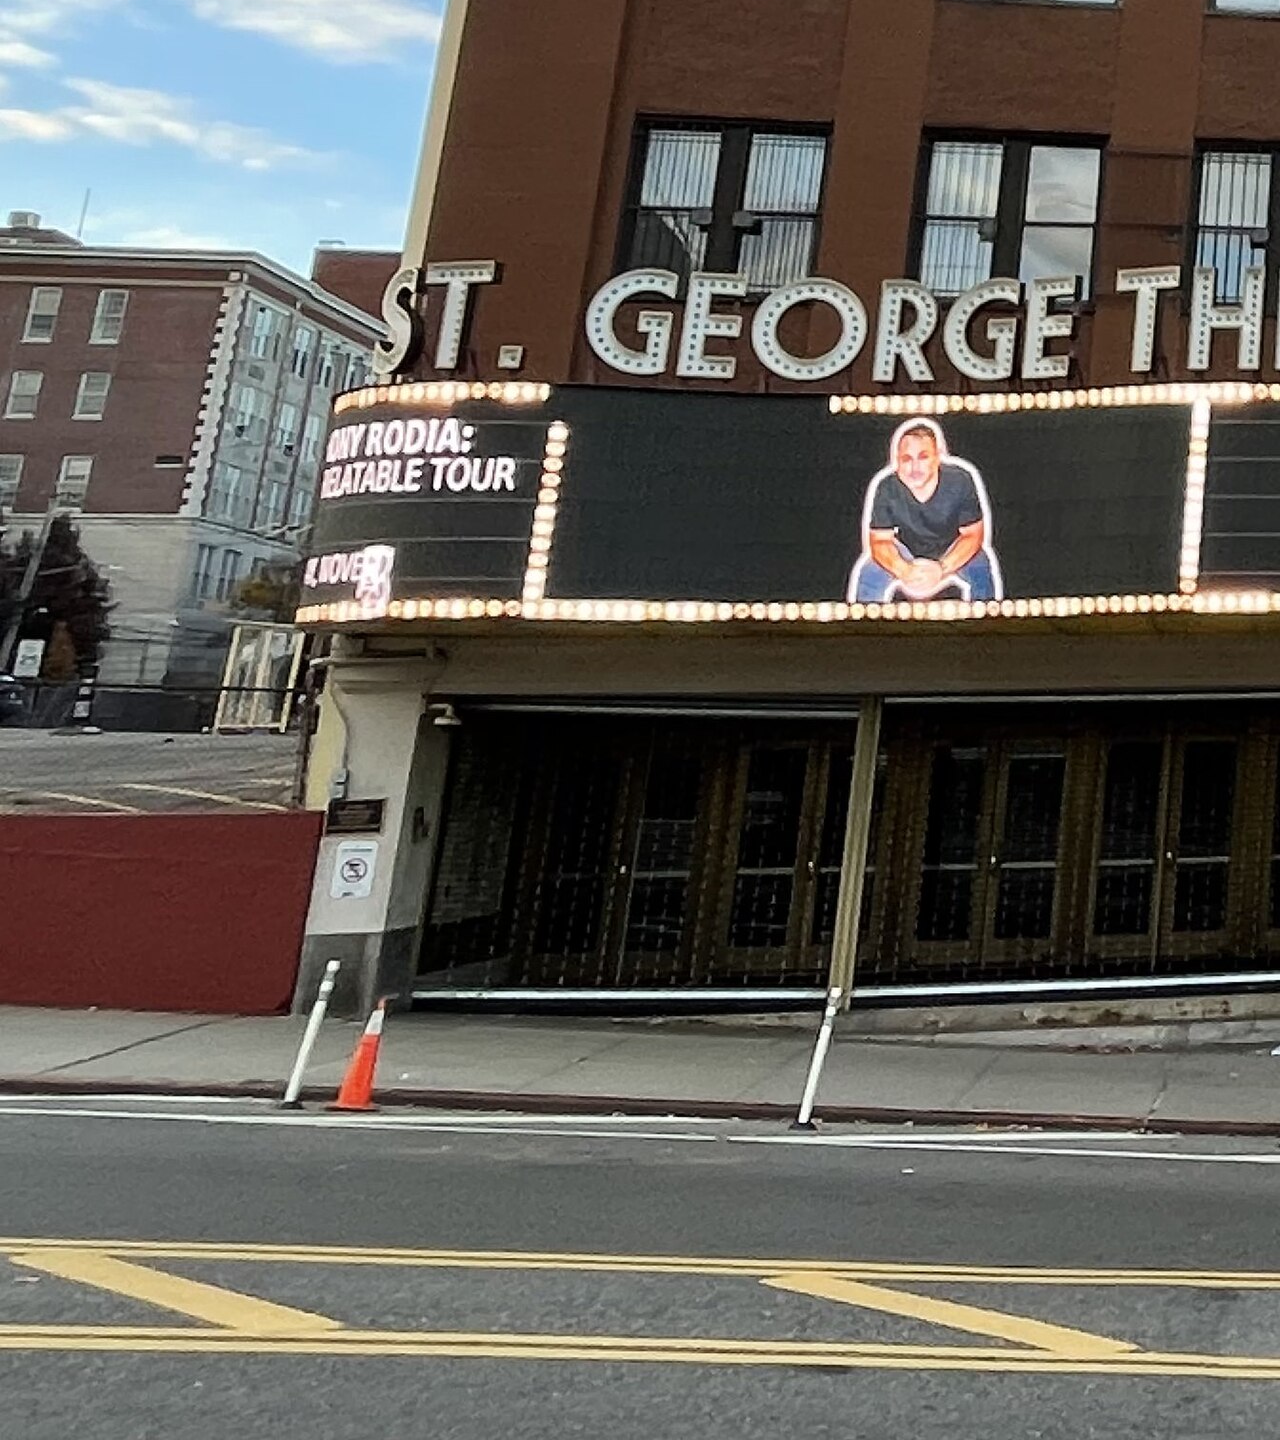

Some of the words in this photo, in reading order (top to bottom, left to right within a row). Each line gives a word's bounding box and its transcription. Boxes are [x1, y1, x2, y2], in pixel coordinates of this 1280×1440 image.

[372, 260, 523, 374] ST.
[585, 267, 1078, 383] GEORGE
[364, 417, 474, 456] RODIA:
[430, 456, 516, 492] TOUR
